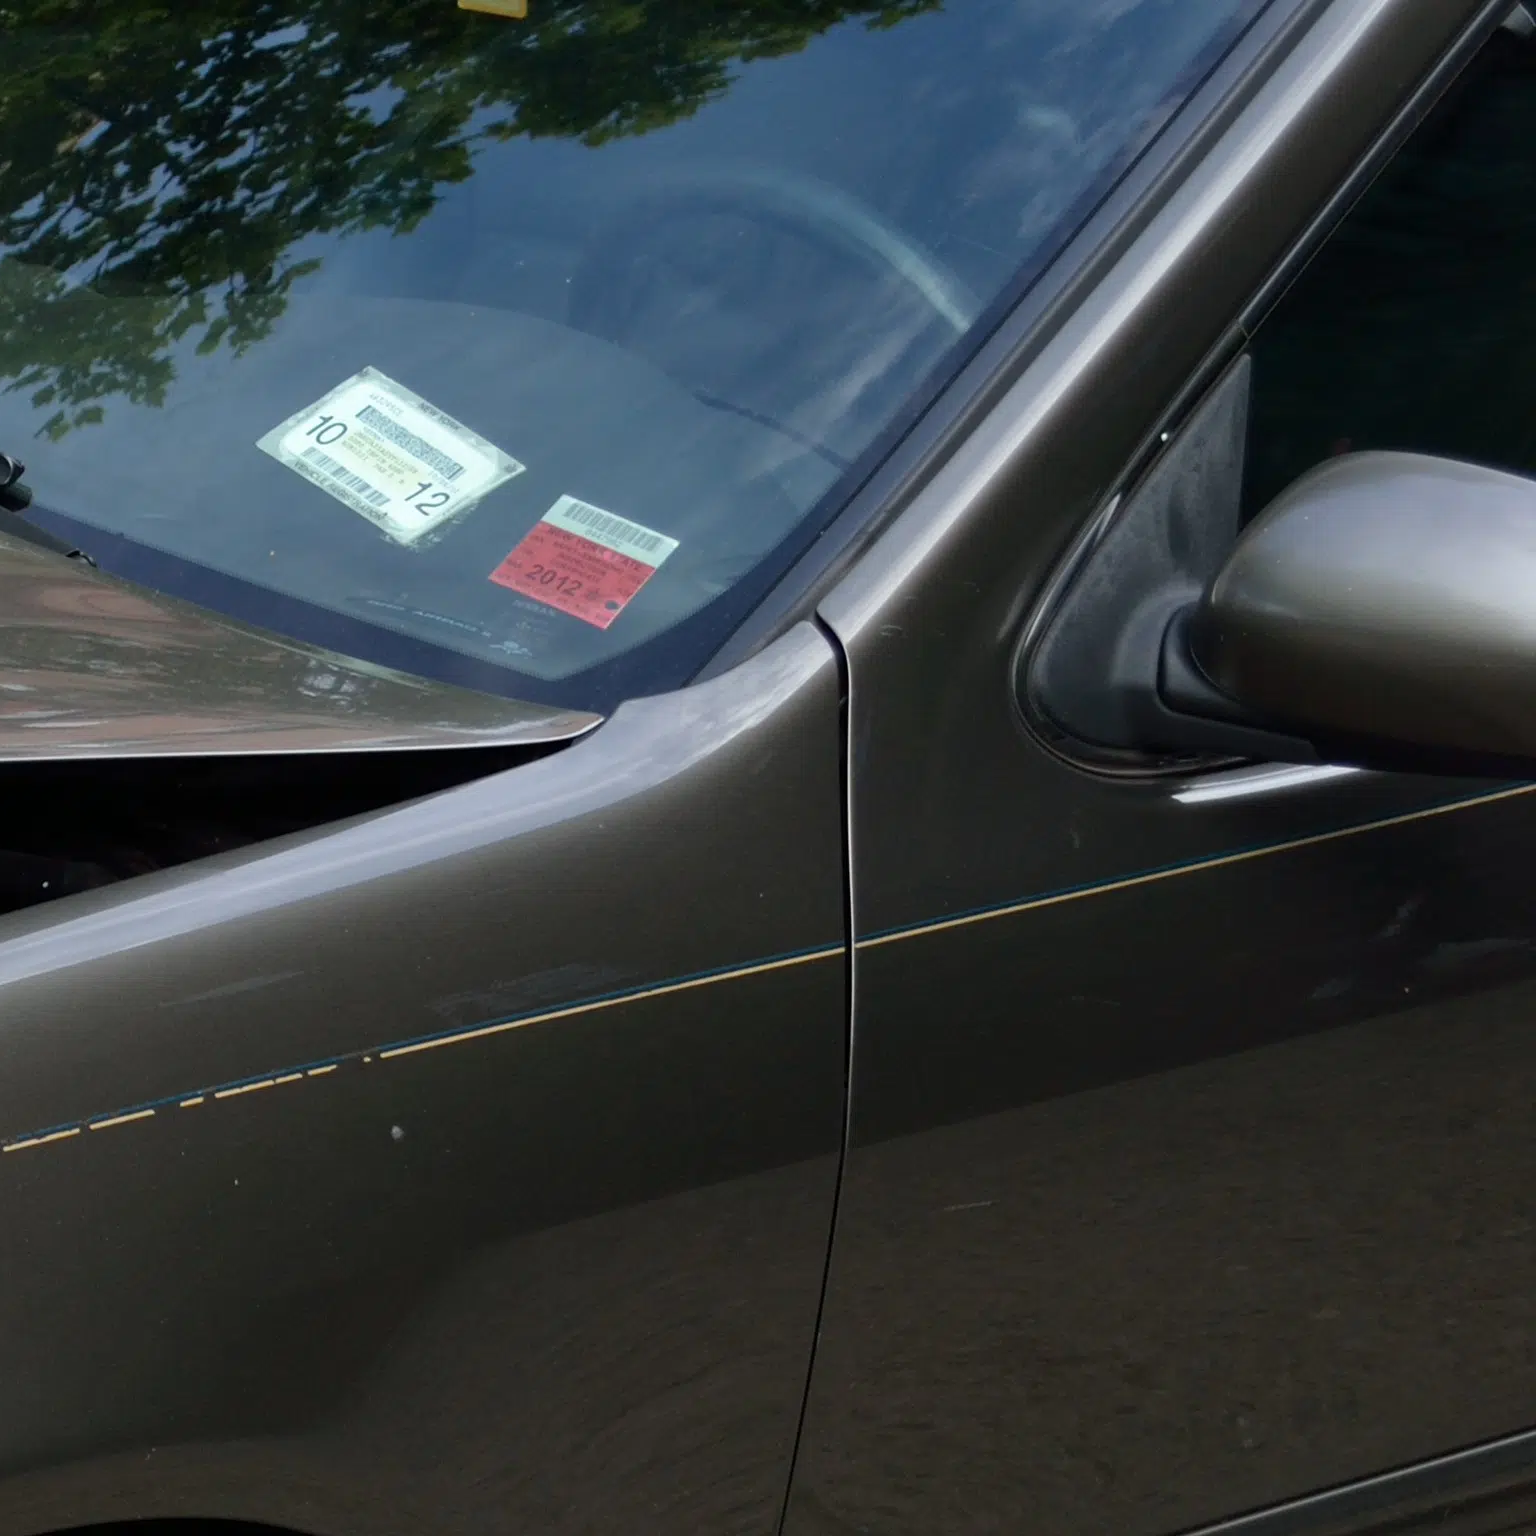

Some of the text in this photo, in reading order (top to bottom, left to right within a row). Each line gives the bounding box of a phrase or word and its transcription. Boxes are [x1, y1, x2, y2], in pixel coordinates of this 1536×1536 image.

[305, 414, 349, 447] 10
[419, 402, 441, 419] NEW
[437, 412, 462, 431] YORK
[292, 461, 330, 488] VEHICLE
[403, 481, 451, 517] 12
[525, 563, 584, 598] 2012
